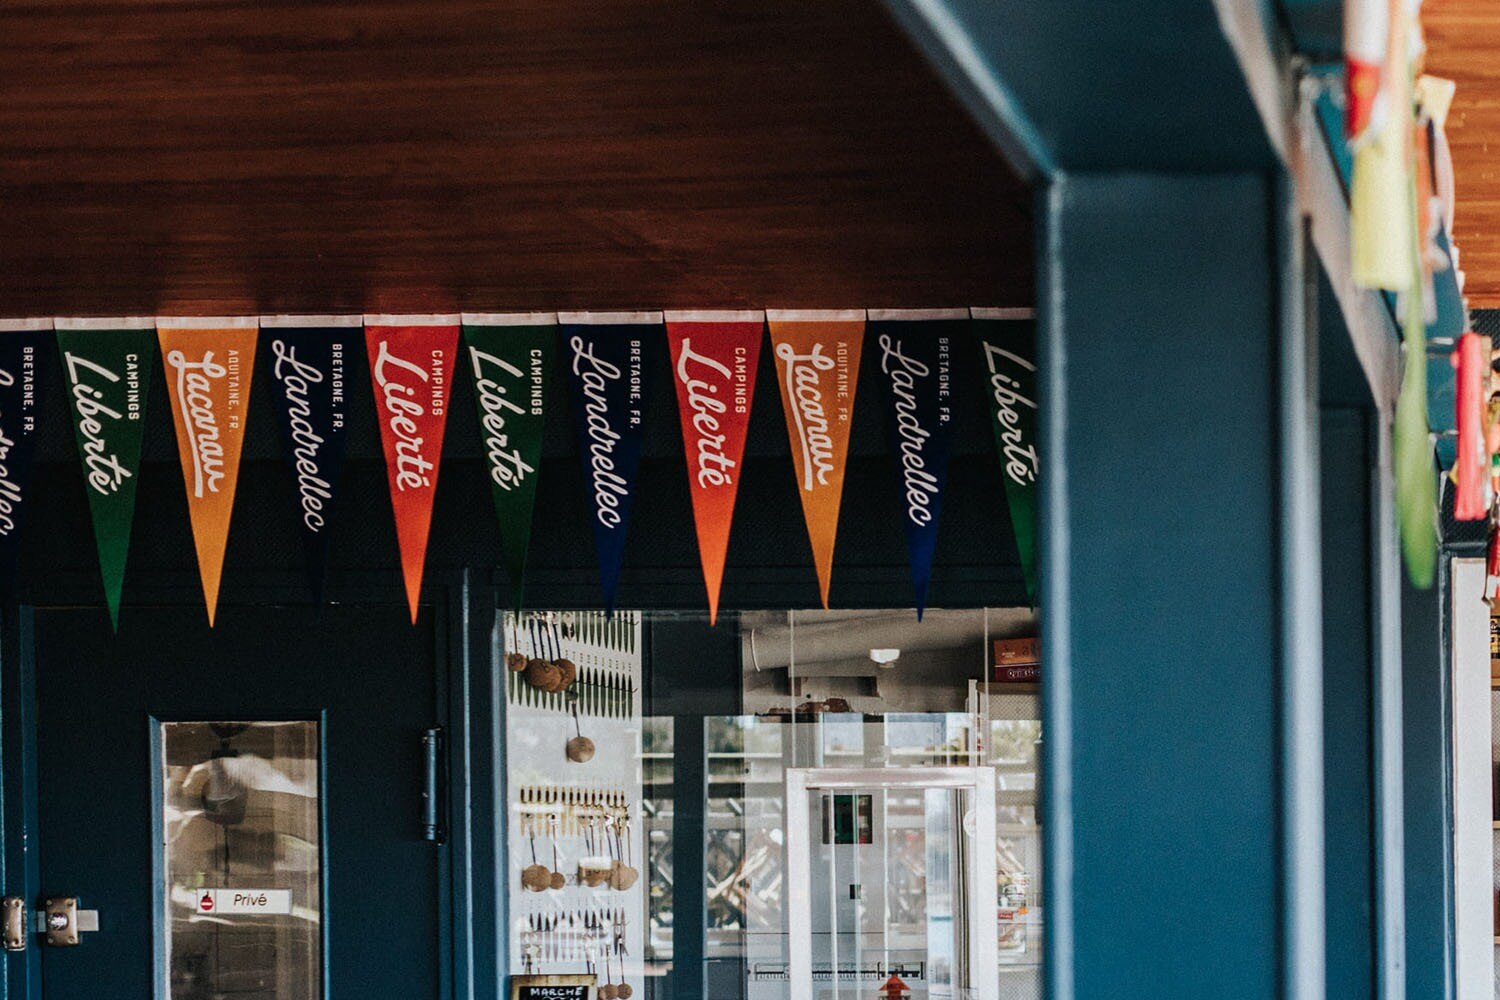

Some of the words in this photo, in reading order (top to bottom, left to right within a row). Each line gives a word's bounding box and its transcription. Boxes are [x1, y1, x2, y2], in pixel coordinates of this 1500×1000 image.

[23, 346, 34, 411] BRETAGNE,
[126, 353, 140, 421] CAMPINGS
[332, 342, 343, 410] BRETAGNE,
[374, 340, 432, 492] Liberté
[431, 349, 444, 417] CAMPINGS
[469, 345, 535, 492] Liberté
[530, 348, 544, 416] CAMPINGS
[629, 339, 641, 405] BRETAGNE,
[677, 337, 736, 489] Liberté
[734, 346, 747, 414] CAMPINGS
[776, 341, 834, 491] Lacanau
[938, 336, 950, 402] BRETAGNE,
[982, 341, 1040, 487] Liberté
[64, 350, 133, 496] Liberté
[167, 349, 225, 499] Lacanau
[272, 339, 332, 533] Landrellec
[570, 335, 628, 530] Landrellec
[879, 333, 940, 528] Landrellec
[233, 893, 267, 906] Privé
[530, 986, 583, 996] MARCHÉ
